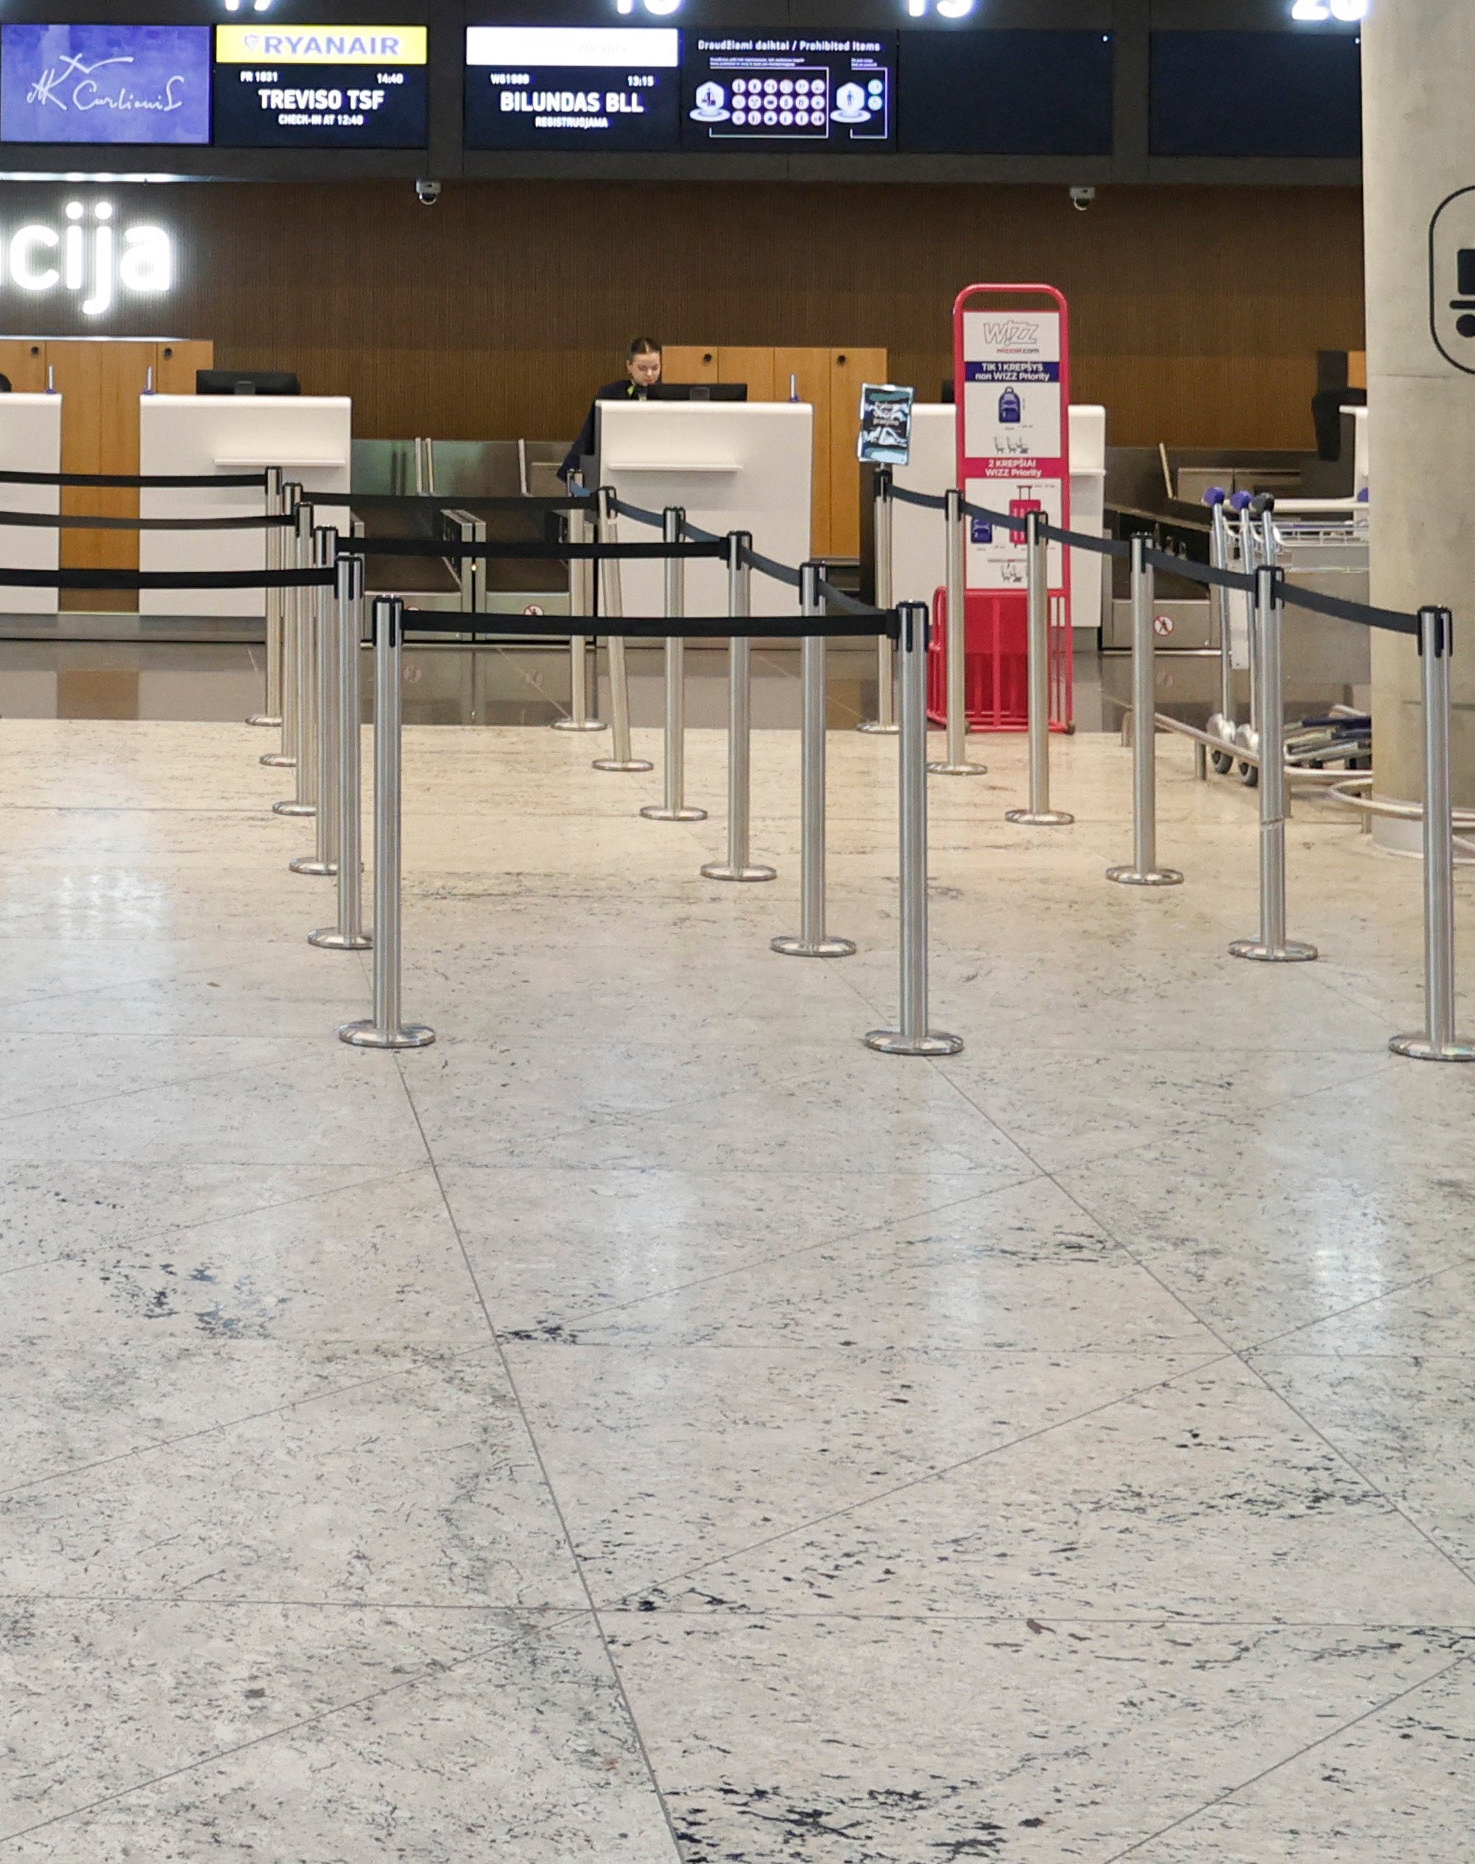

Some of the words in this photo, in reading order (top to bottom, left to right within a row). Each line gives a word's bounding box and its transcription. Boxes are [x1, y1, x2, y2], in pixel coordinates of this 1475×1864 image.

[263, 35, 400, 55] RYANAIR
[800, 41, 850, 52] Prohibited
[257, 89, 342, 111] TREVISO
[346, 90, 385, 111] TSF
[500, 90, 600, 113] BILUNDAS
[606, 92, 645, 114] BLL
[278, 113, 322, 126] CHECK-IN
[323, 114, 336, 126] AT
[337, 114, 365, 127] 12:40
[981, 362, 997, 373] TIK
[1003, 361, 1044, 373] KREPŠYS
[975, 372, 992, 381] non
[994, 371, 1017, 381] WIZZ
[1019, 371, 1050, 382] Priority
[988, 459, 994, 468] 2
[985, 469, 1009, 478] WIZZ
[1011, 468, 1042, 478] Priority
